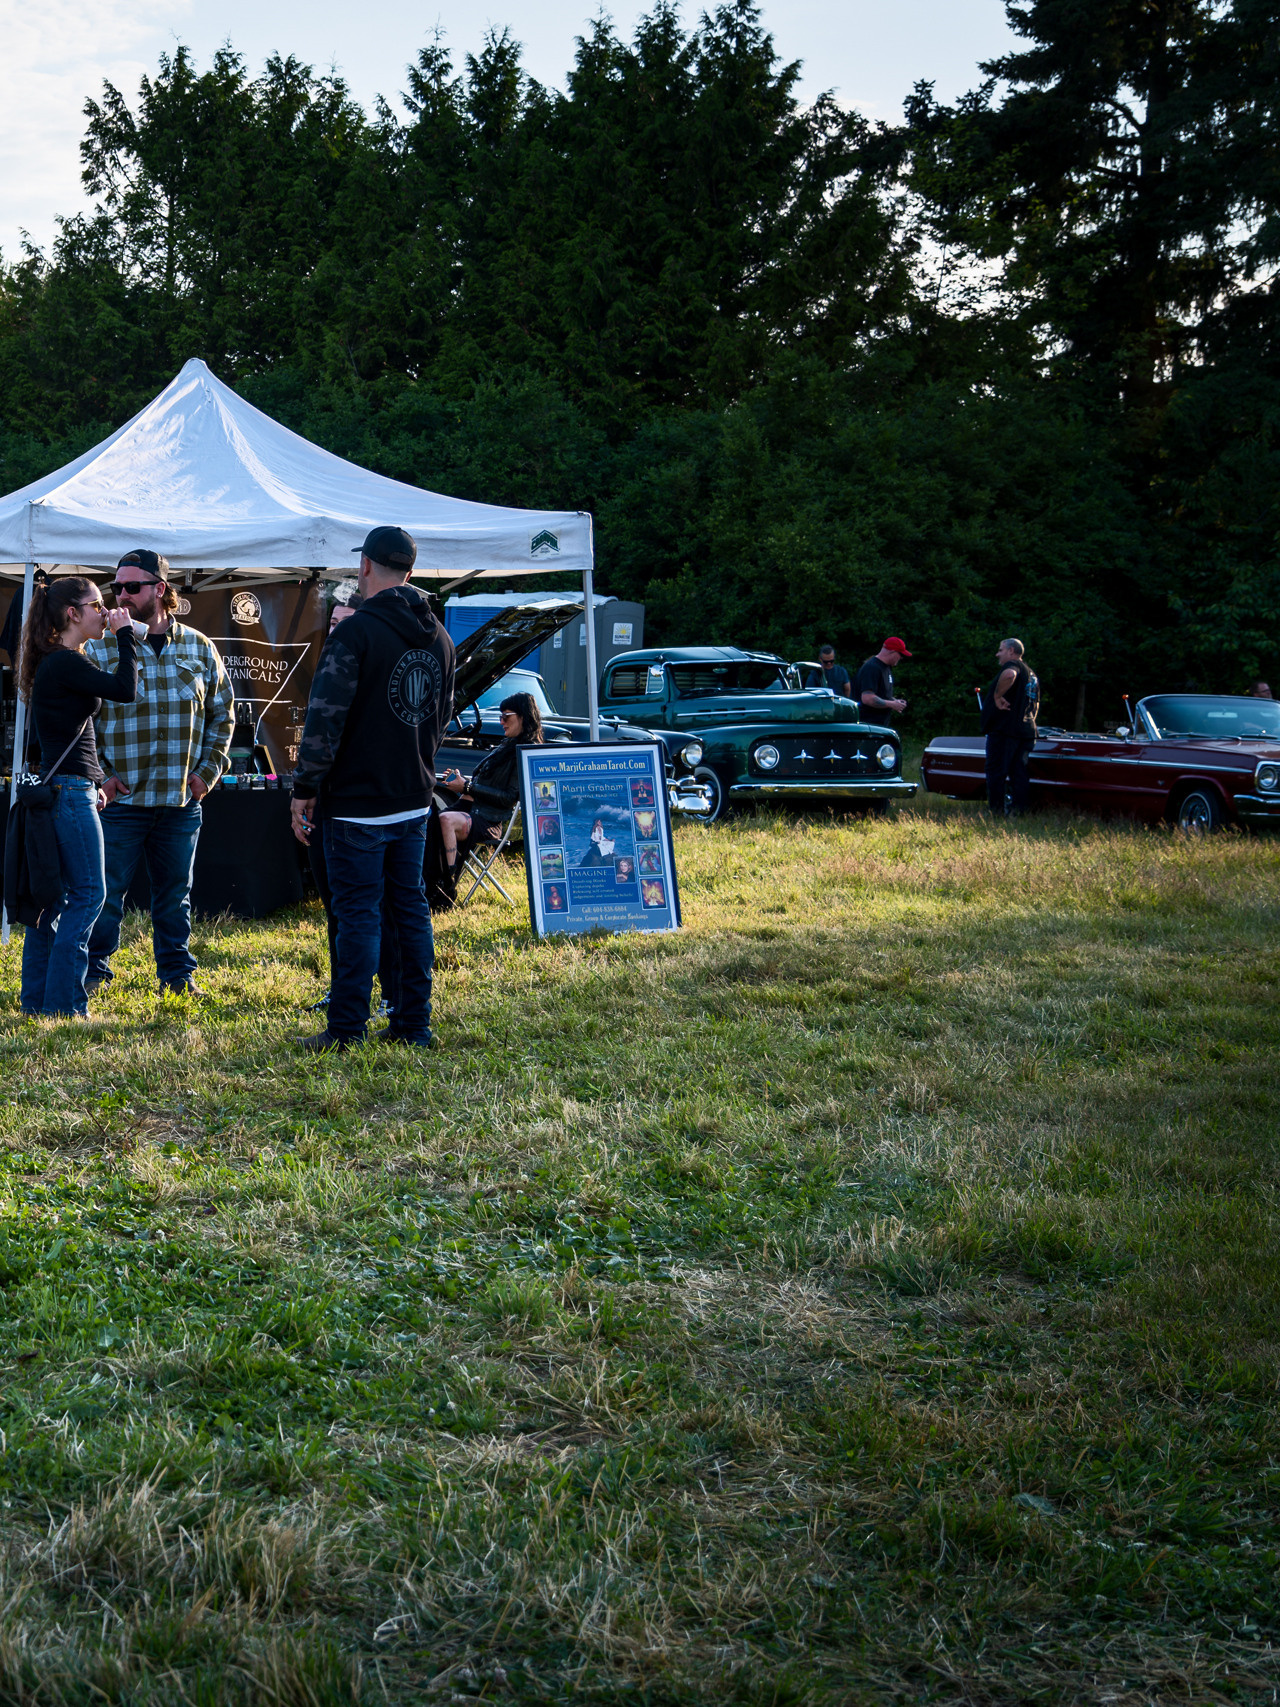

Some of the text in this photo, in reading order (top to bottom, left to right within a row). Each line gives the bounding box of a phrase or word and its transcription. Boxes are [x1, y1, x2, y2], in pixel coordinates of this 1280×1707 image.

[222, 655, 289, 671] DERGROUND
[227, 668, 282, 683] TANICALS
[390, 661, 406, 698] INDIAN
[538, 759, 646, 774] www.MarjiGrahamTarot.Com
[562, 783, 624, 793] Marji Graham
